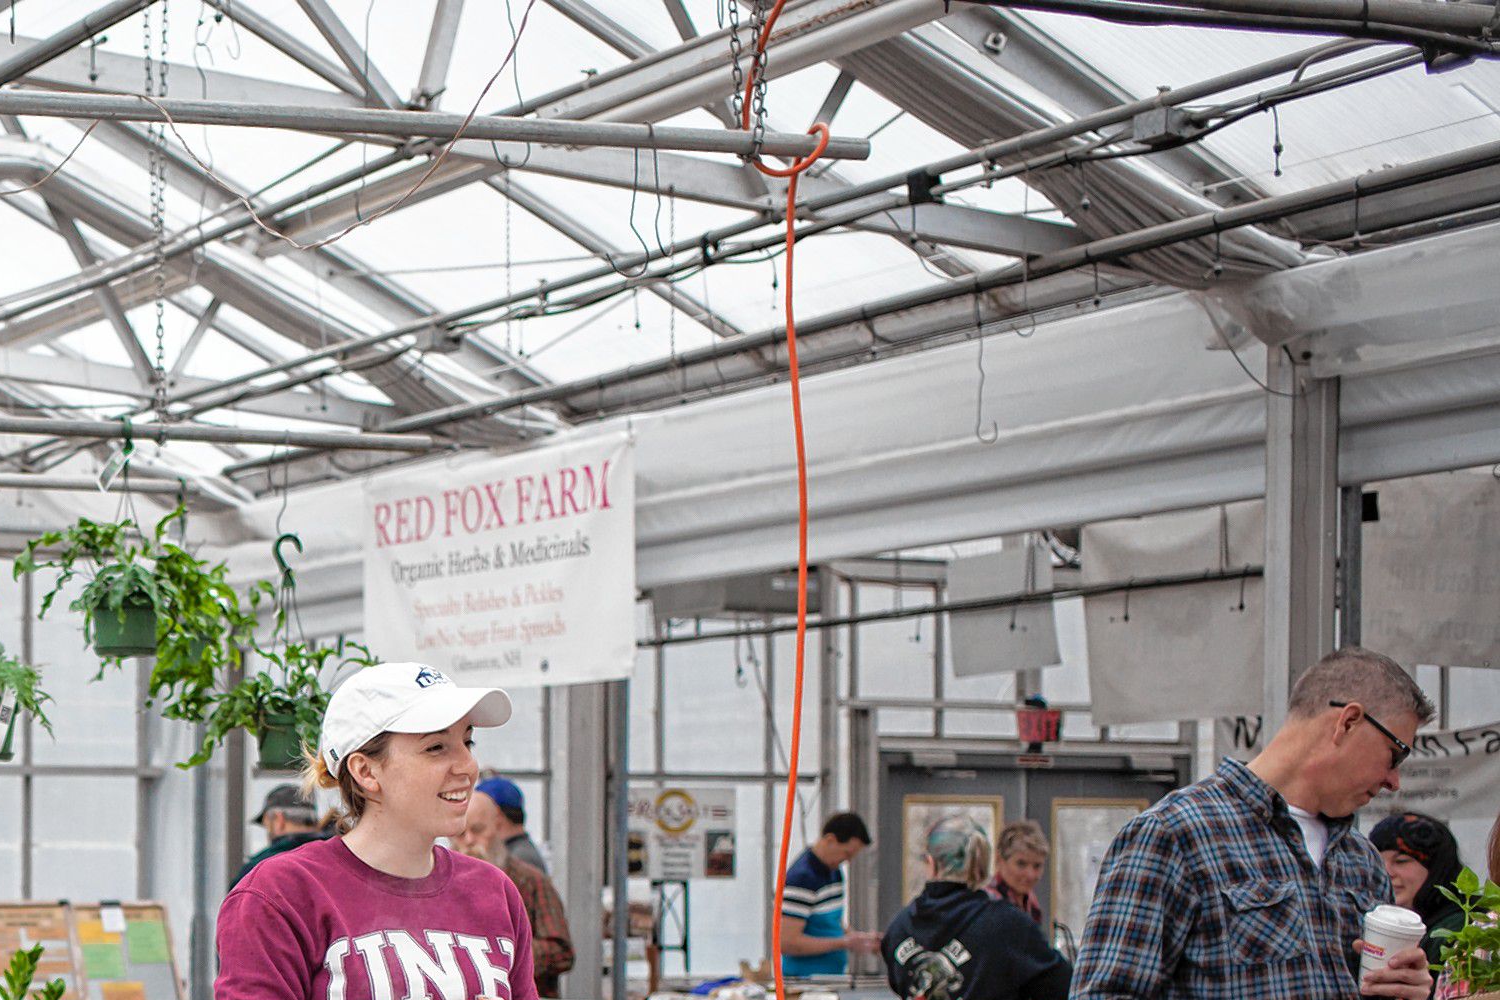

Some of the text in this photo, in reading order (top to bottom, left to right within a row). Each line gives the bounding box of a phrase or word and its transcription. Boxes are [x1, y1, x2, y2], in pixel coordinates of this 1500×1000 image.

[374, 460, 612, 548] RED FOX FARM
[391, 530, 590, 589] Organic Herbs & Medicinals
